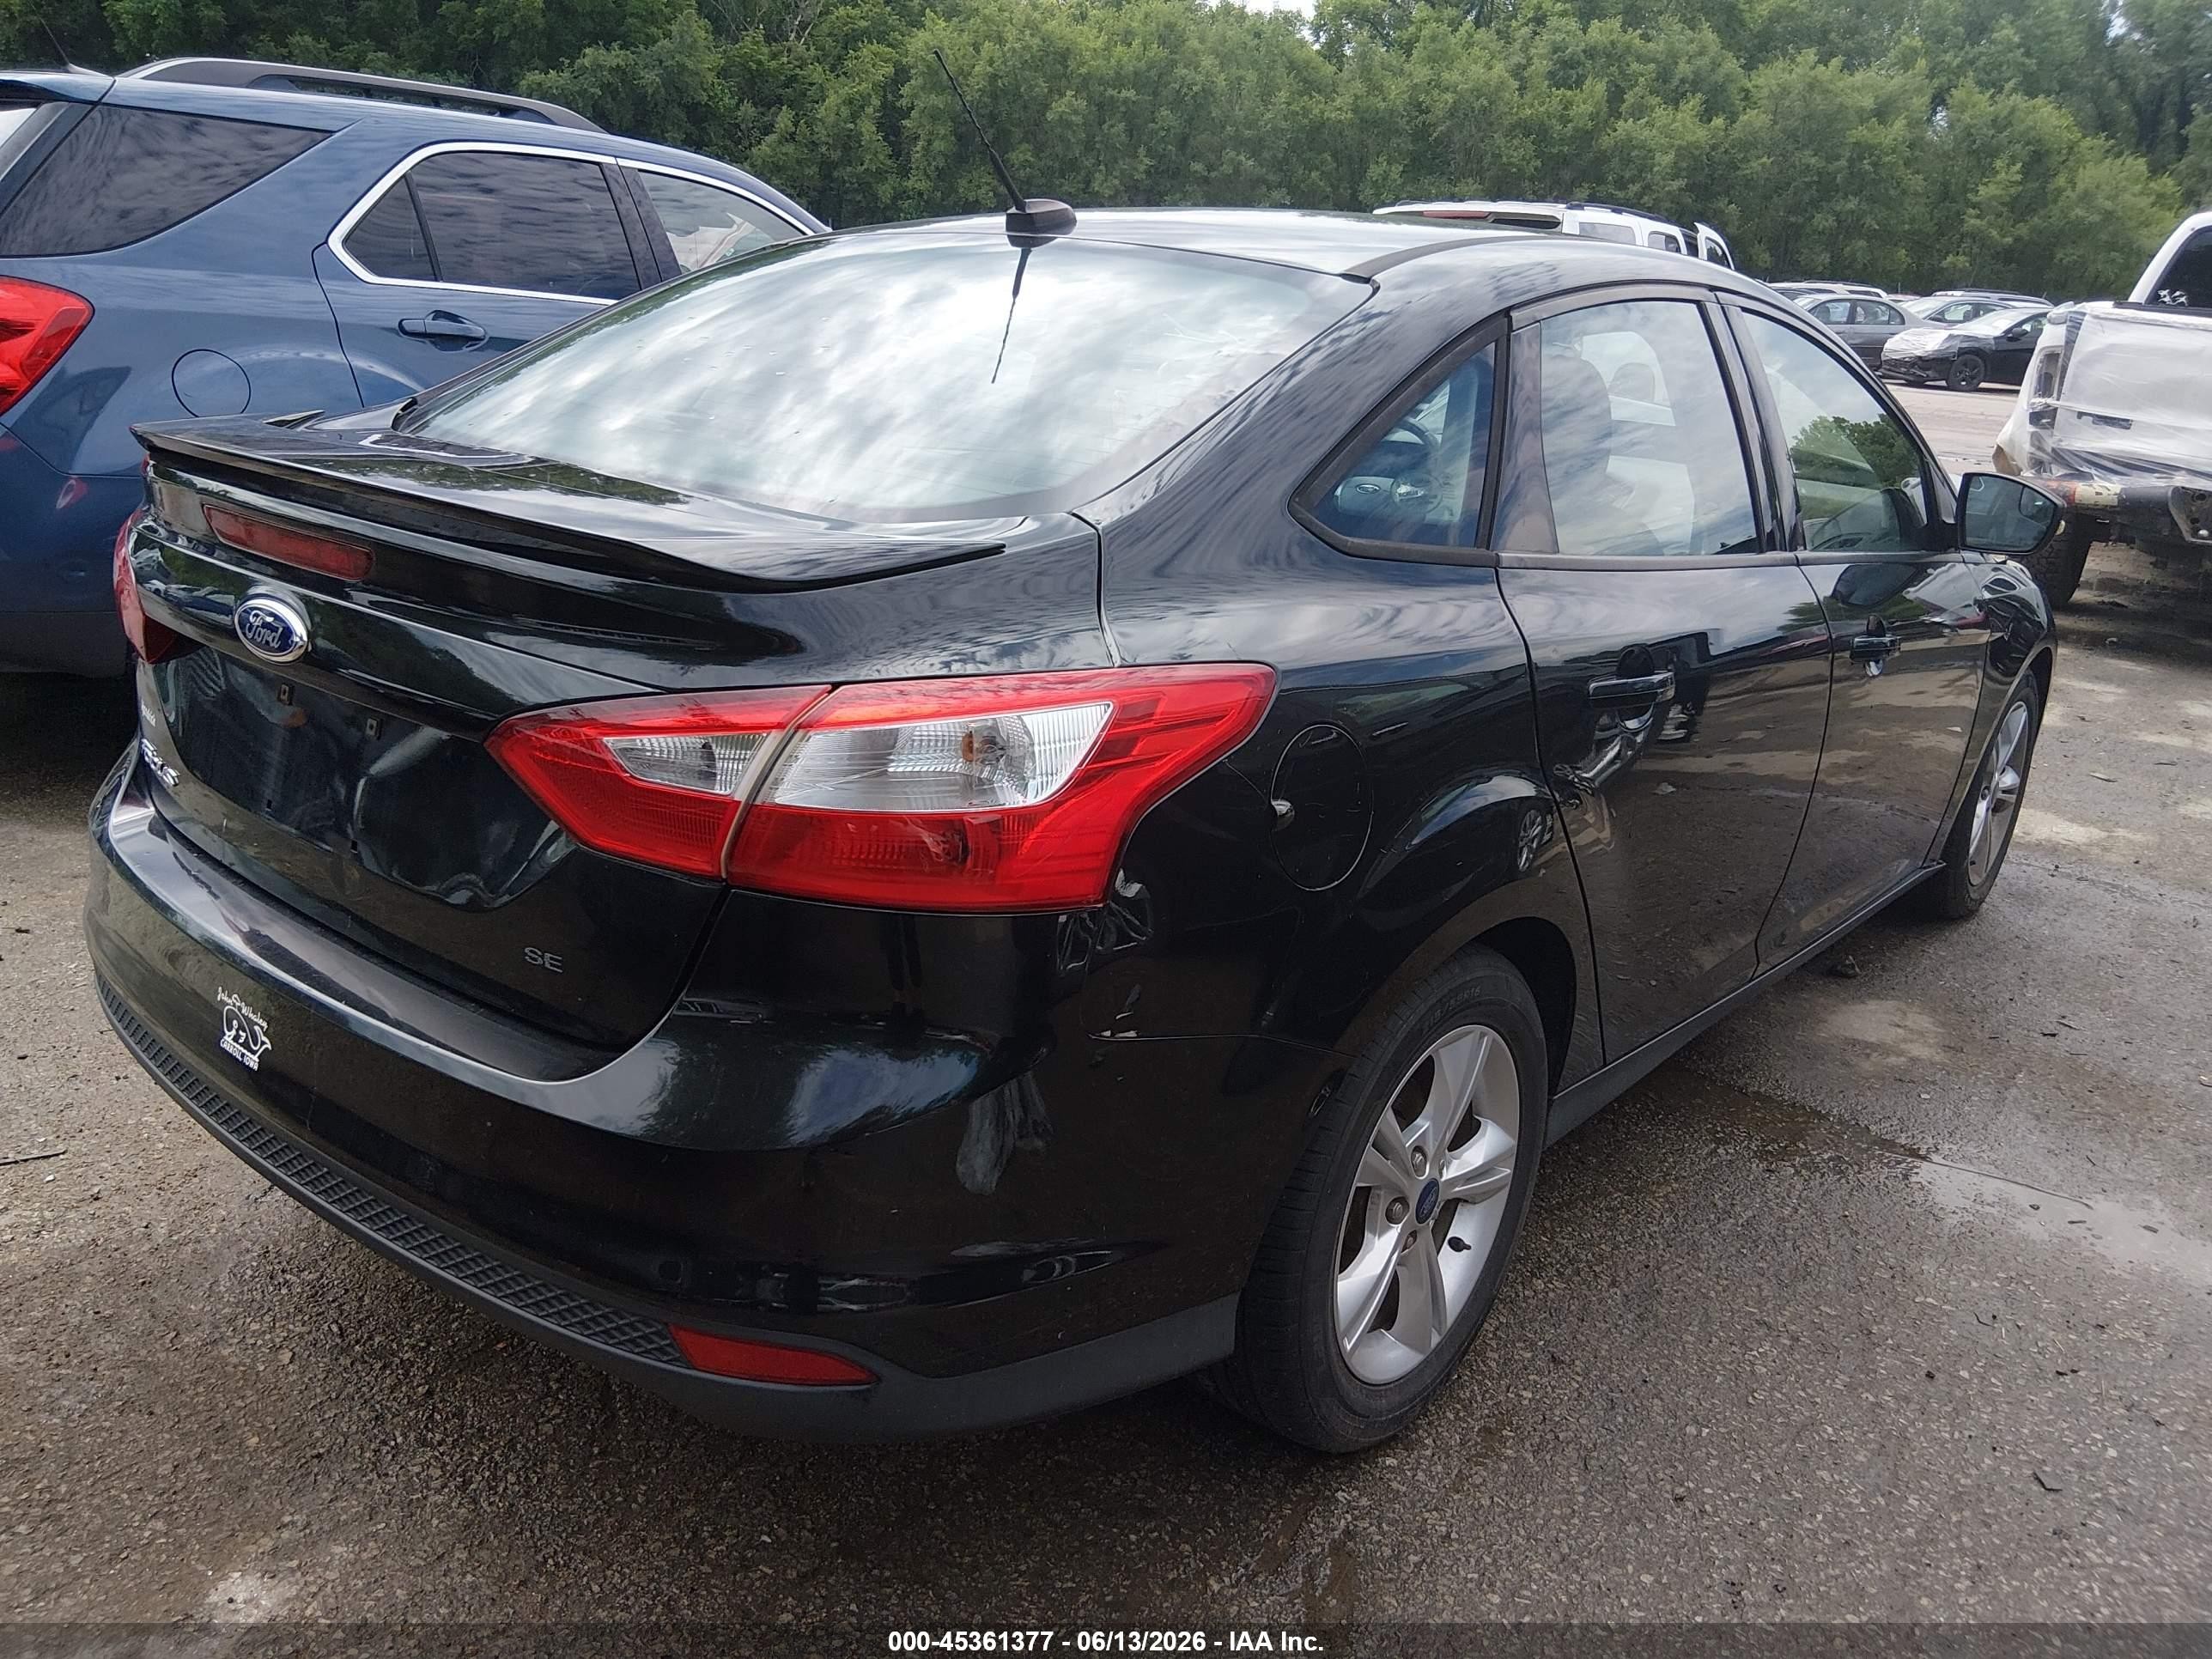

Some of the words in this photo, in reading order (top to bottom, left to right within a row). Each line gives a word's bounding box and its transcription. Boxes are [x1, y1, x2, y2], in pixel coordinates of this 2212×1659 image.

[246, 610, 283, 648] Ford
[524, 946, 563, 973] SE
[243, 1054, 259, 1072] IOWA
